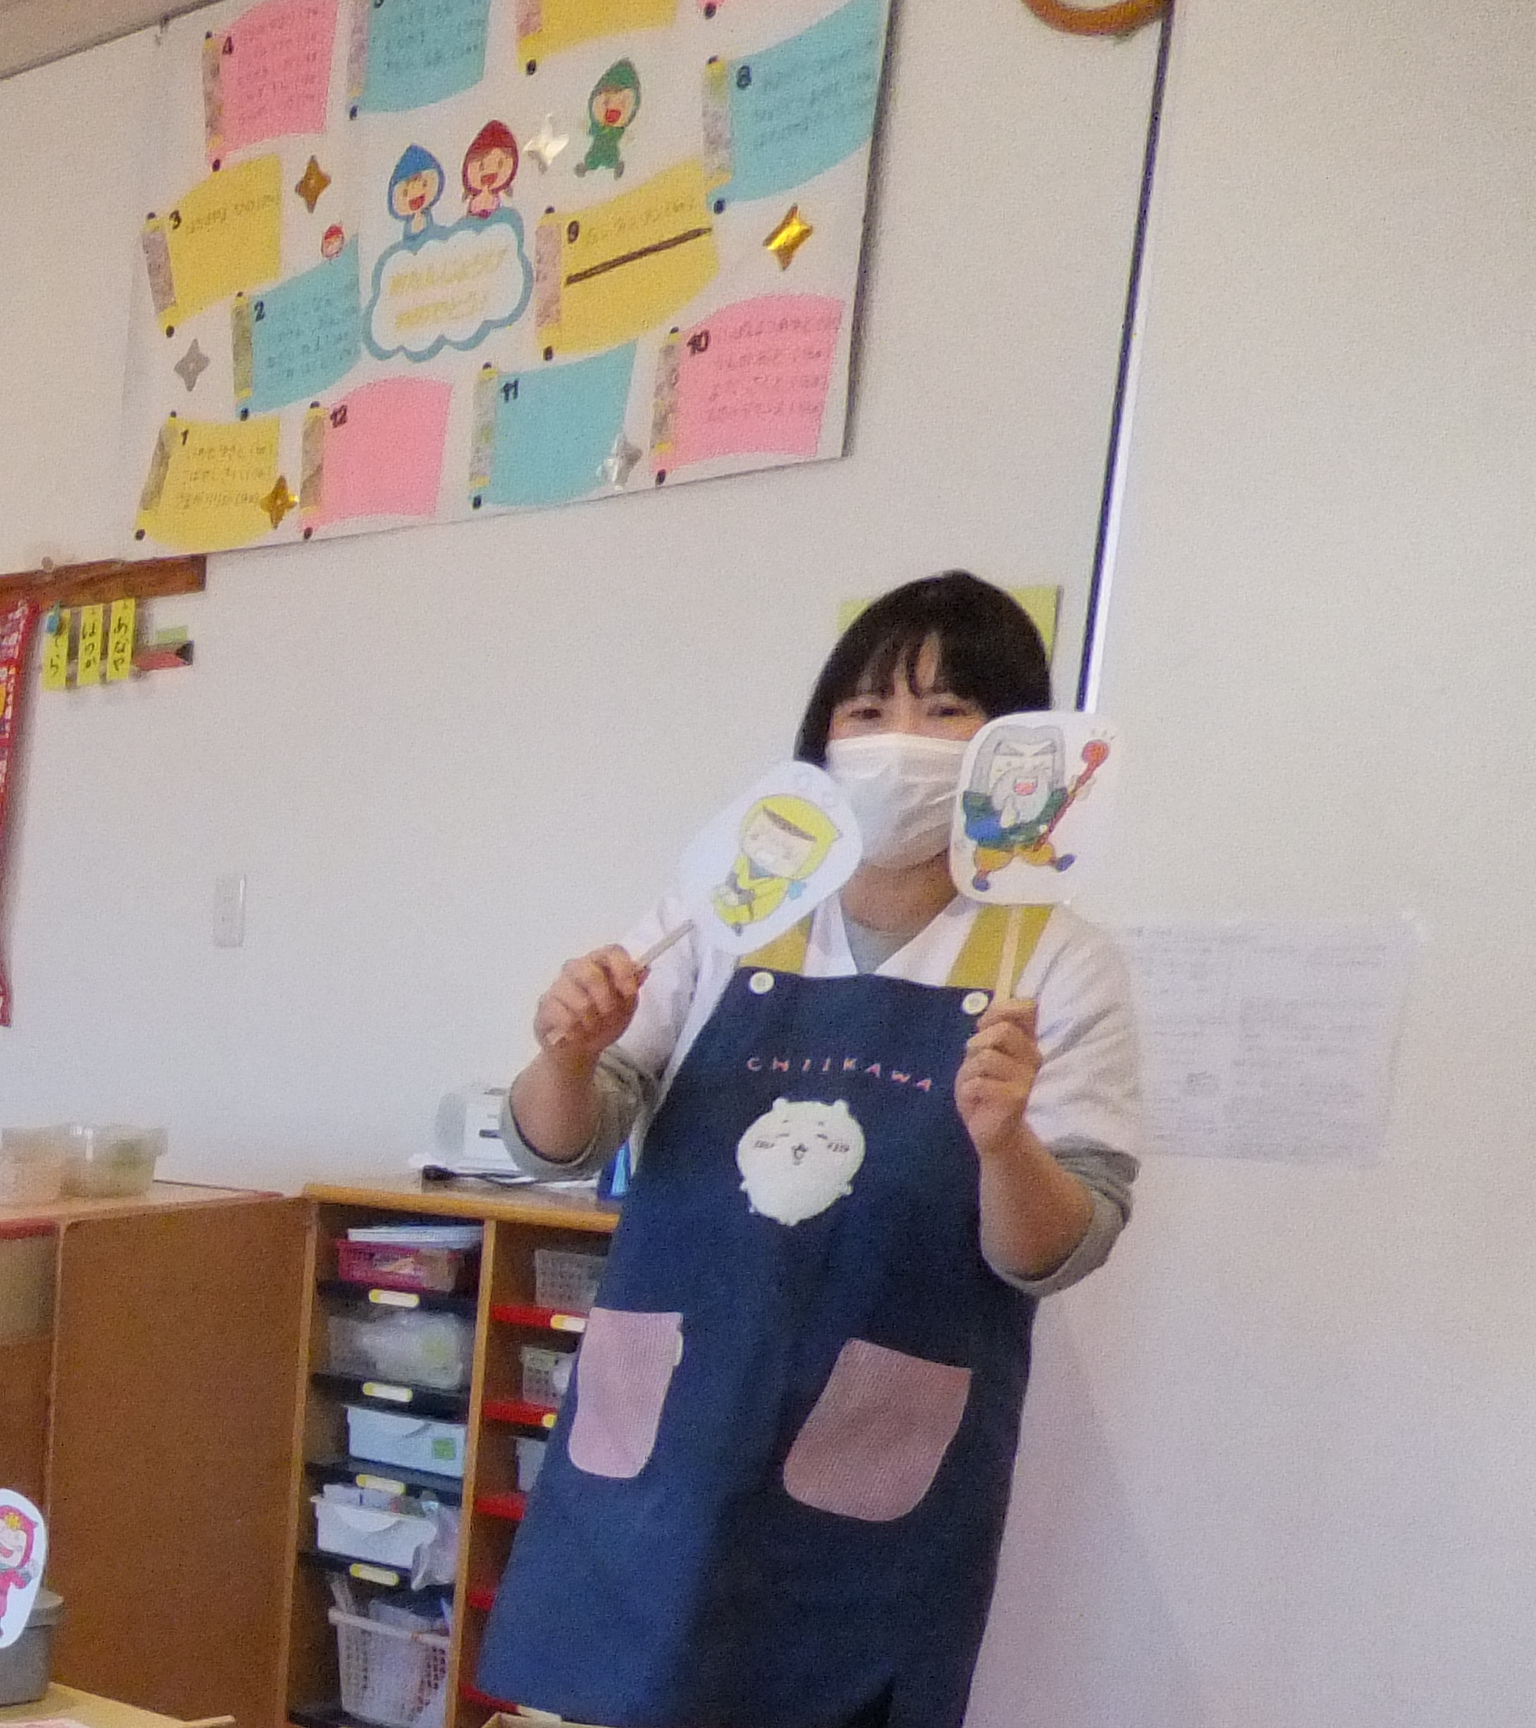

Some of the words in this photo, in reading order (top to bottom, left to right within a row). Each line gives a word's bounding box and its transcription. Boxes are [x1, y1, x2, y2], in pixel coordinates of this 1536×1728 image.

[169, 209, 182, 230] 3
[254, 301, 266, 322] 2
[687, 329, 710, 357] 10
[501, 378, 519, 403] 11
[330, 404, 348, 428] 12
[181, 429, 189, 446] 1
[746, 1056, 933, 1092] CHIIKAWA
